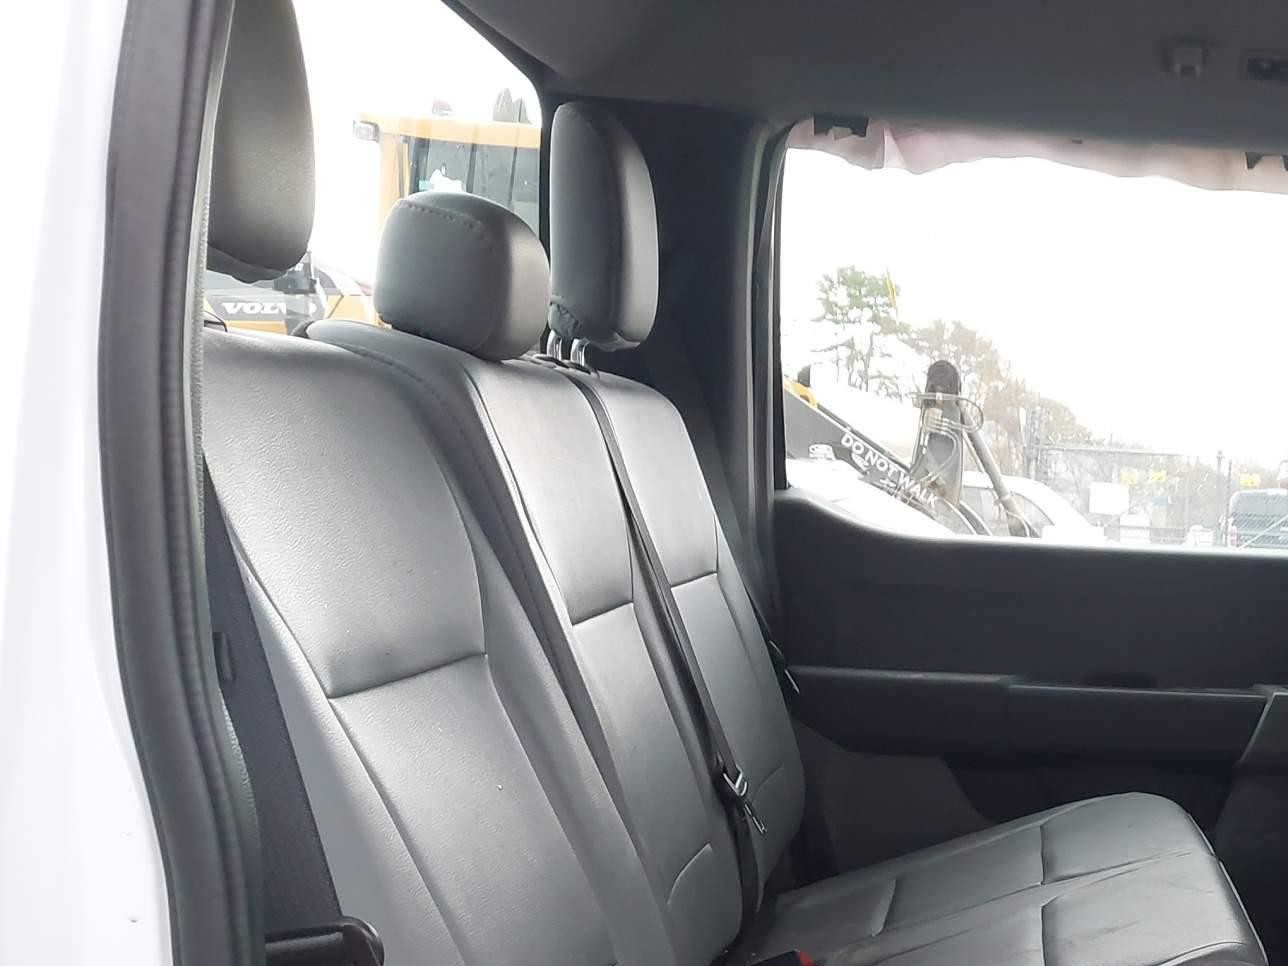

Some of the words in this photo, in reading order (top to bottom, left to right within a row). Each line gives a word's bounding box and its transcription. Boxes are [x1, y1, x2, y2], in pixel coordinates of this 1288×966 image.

[841, 433, 864, 455] DO
[865, 451, 898, 477] NOT
[899, 474, 938, 508] WALK
